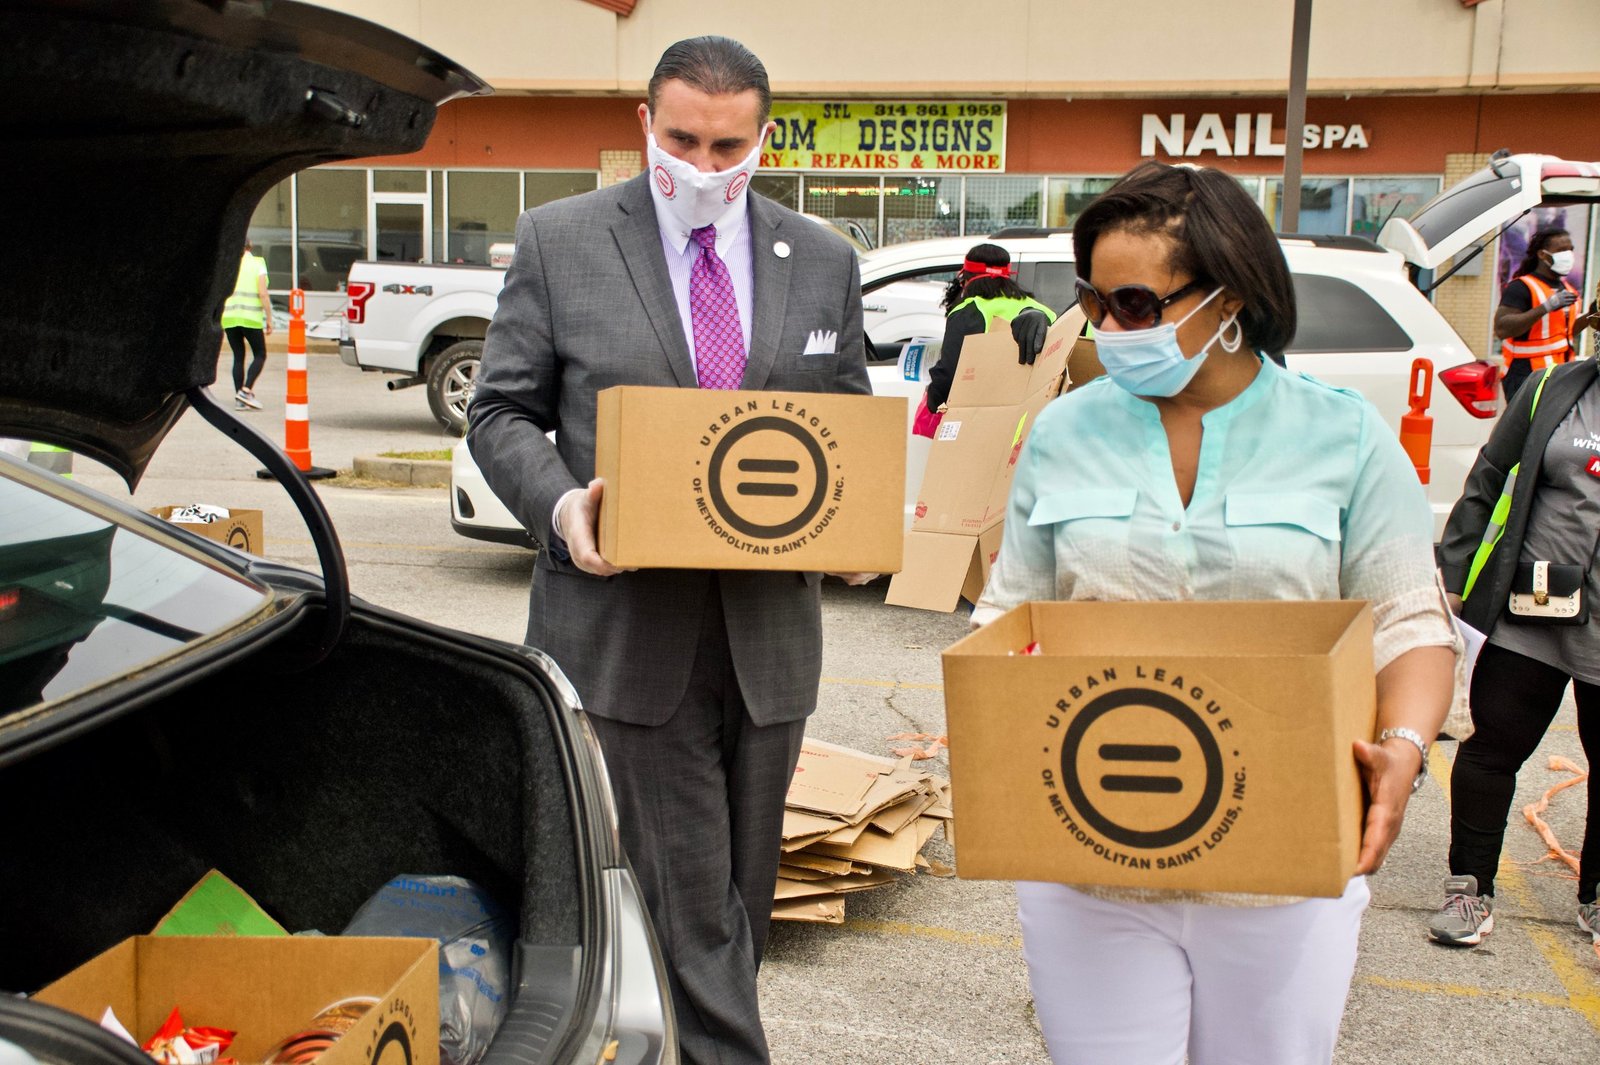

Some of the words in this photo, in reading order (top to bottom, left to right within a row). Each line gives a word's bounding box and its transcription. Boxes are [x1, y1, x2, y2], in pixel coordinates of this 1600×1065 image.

[823, 103, 851, 119] STL
[874, 104, 907, 117] 314
[916, 104, 949, 117] 361
[957, 103, 1003, 117] 1952
[771, 118, 817, 151] OM
[858, 118, 993, 151] DESIGNS
[1140, 113, 1287, 157] NAIL
[1302, 124, 1369, 149] SPA
[759, 153, 784, 168] RY
[811, 153, 899, 169] REPAIRS
[910, 154, 924, 169] &
[936, 154, 1000, 170] MORE
[700, 400, 759, 447] URBAN
[771, 399, 838, 451] LEAGUE
[692, 477, 703, 494] OF
[832, 476, 845, 502] INC.
[695, 497, 770, 555] METROPOLITAN
[808, 505, 840, 539] LOUIS,
[773, 536, 808, 555] SAINT
[1046, 667, 1117, 729] URBAN
[1136, 665, 1233, 732] LEAGUE
[1041, 768, 1056, 790] OF
[1232, 766, 1246, 801] INC.
[1048, 793, 1151, 870] METROPOLITAN
[1203, 805, 1243, 850] LOUIS,
[1156, 845, 1203, 870] SAINT
